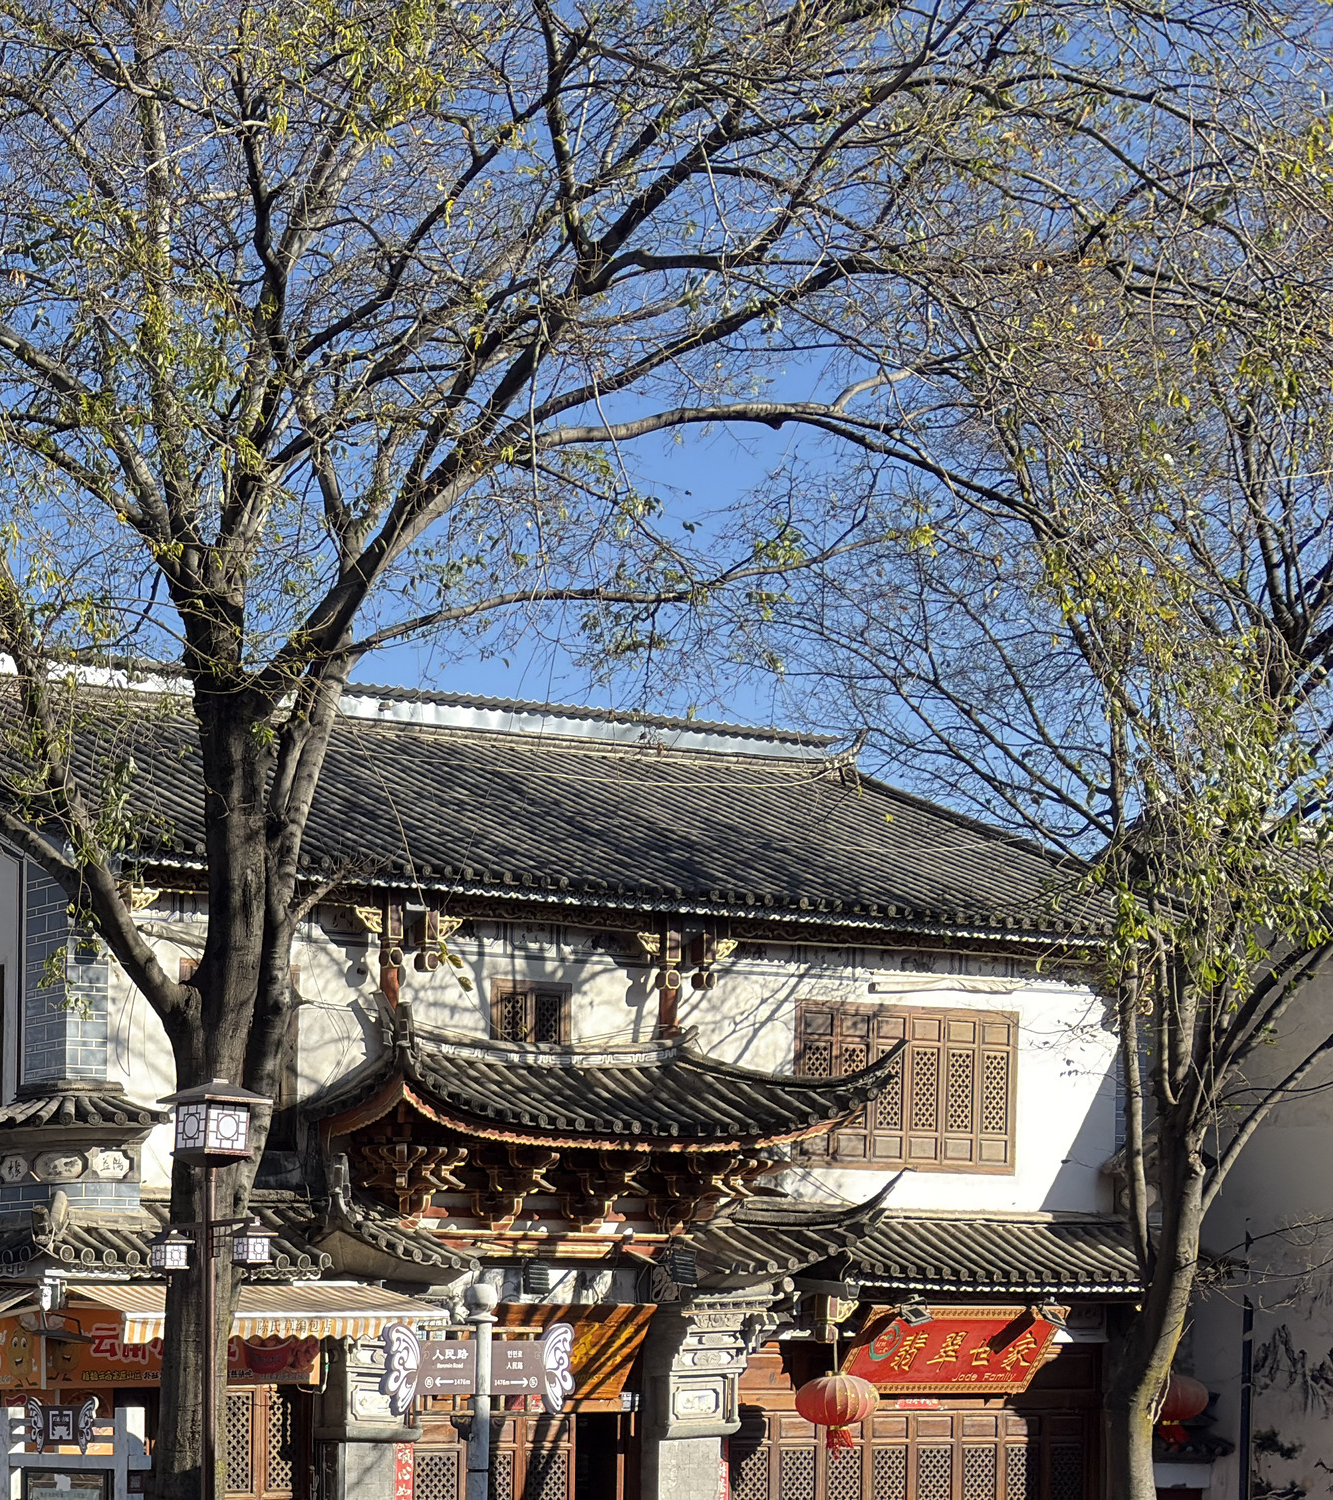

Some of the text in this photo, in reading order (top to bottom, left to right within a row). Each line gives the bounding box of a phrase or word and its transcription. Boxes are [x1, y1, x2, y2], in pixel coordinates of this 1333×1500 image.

[432, 1349, 469, 1360] 人民路
[507, 1350, 523, 1359] 인민로
[890, 1331, 1037, 1372] 翡翠世家
[506, 1361, 524, 1370] 人民路
[951, 1372, 1016, 1382] Jade Family
[494, 1378, 510, 1386] 1476m
